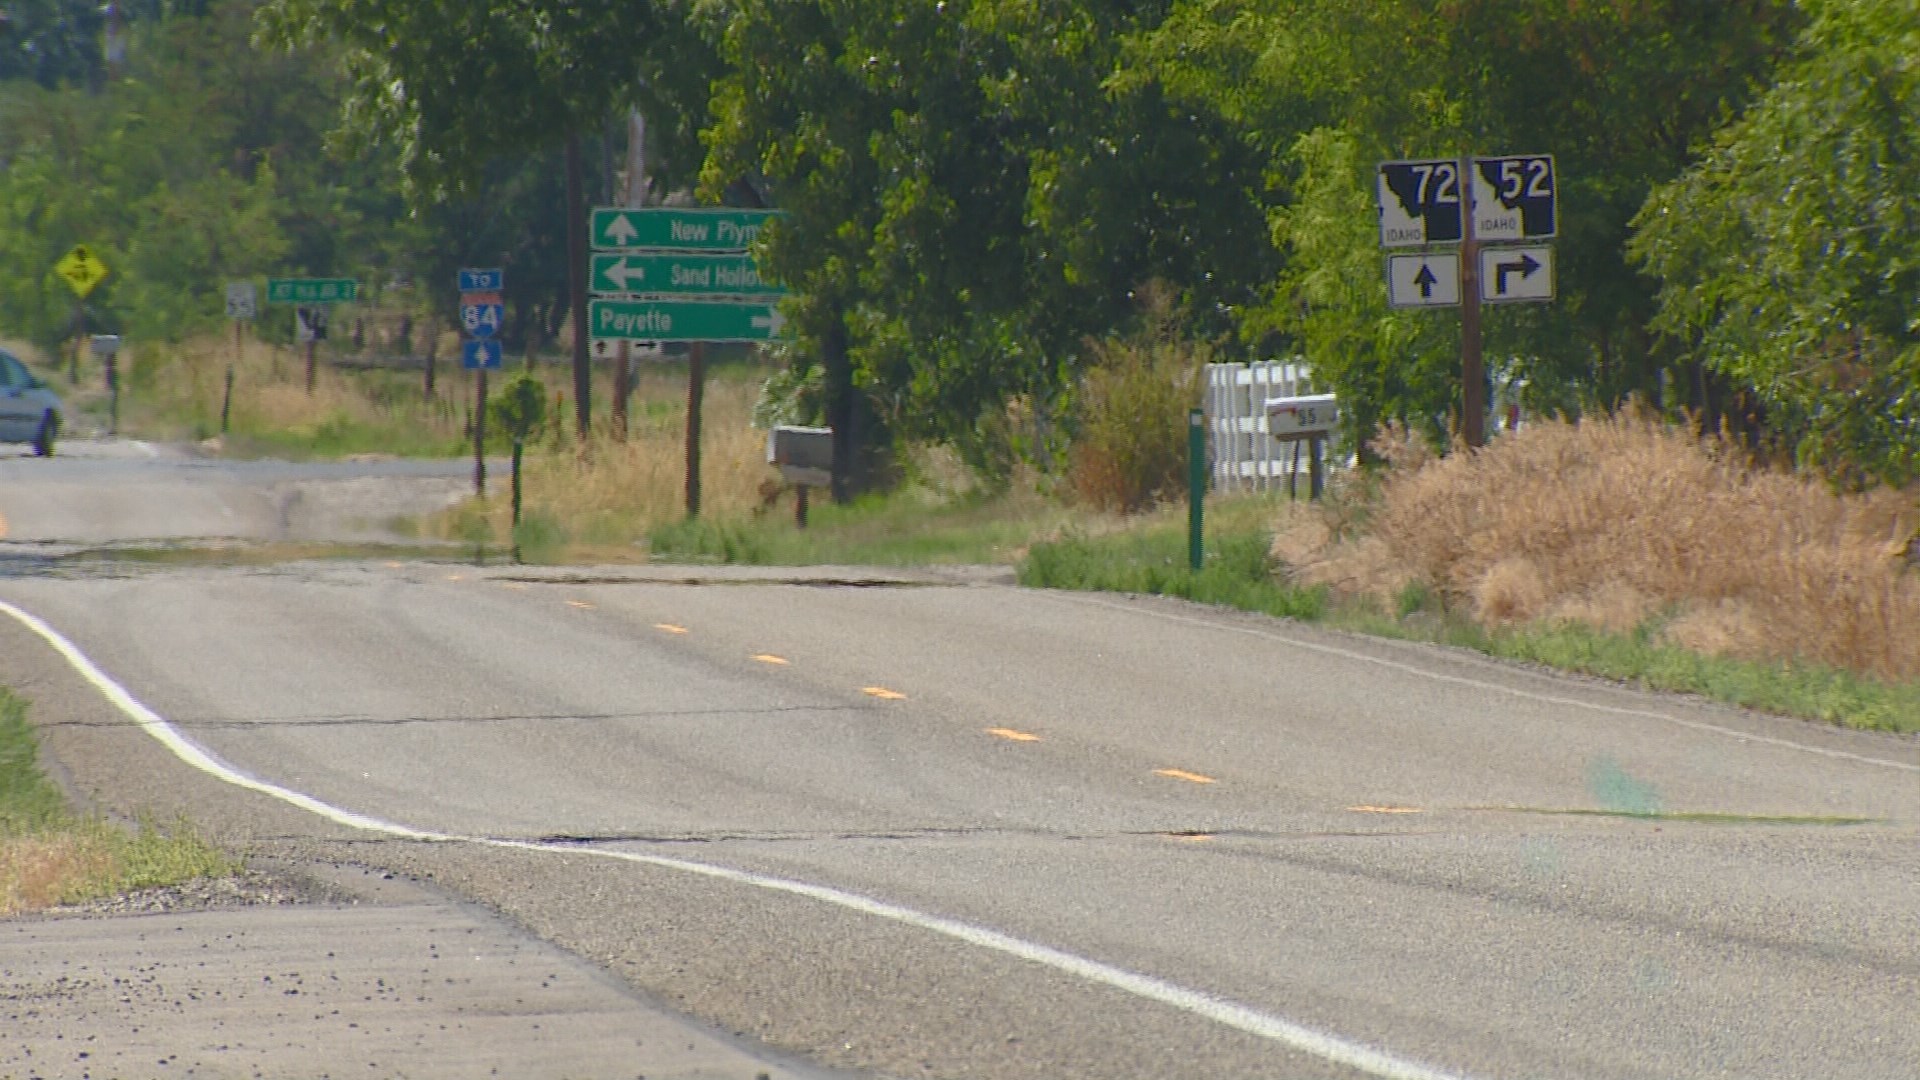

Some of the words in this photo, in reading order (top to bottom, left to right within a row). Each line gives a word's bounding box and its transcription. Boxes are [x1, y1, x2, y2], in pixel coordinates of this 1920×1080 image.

[1412, 163, 1459, 205] 72
[1501, 159, 1551, 200] 52
[670, 219, 709, 242] New
[1386, 228, 1422, 242] IDAHO
[1480, 218, 1517, 232] IDAHO
[468, 272, 492, 288] TO
[670, 263, 710, 287] Sand
[464, 304, 498, 330] 84
[600, 307, 673, 335] Payette
